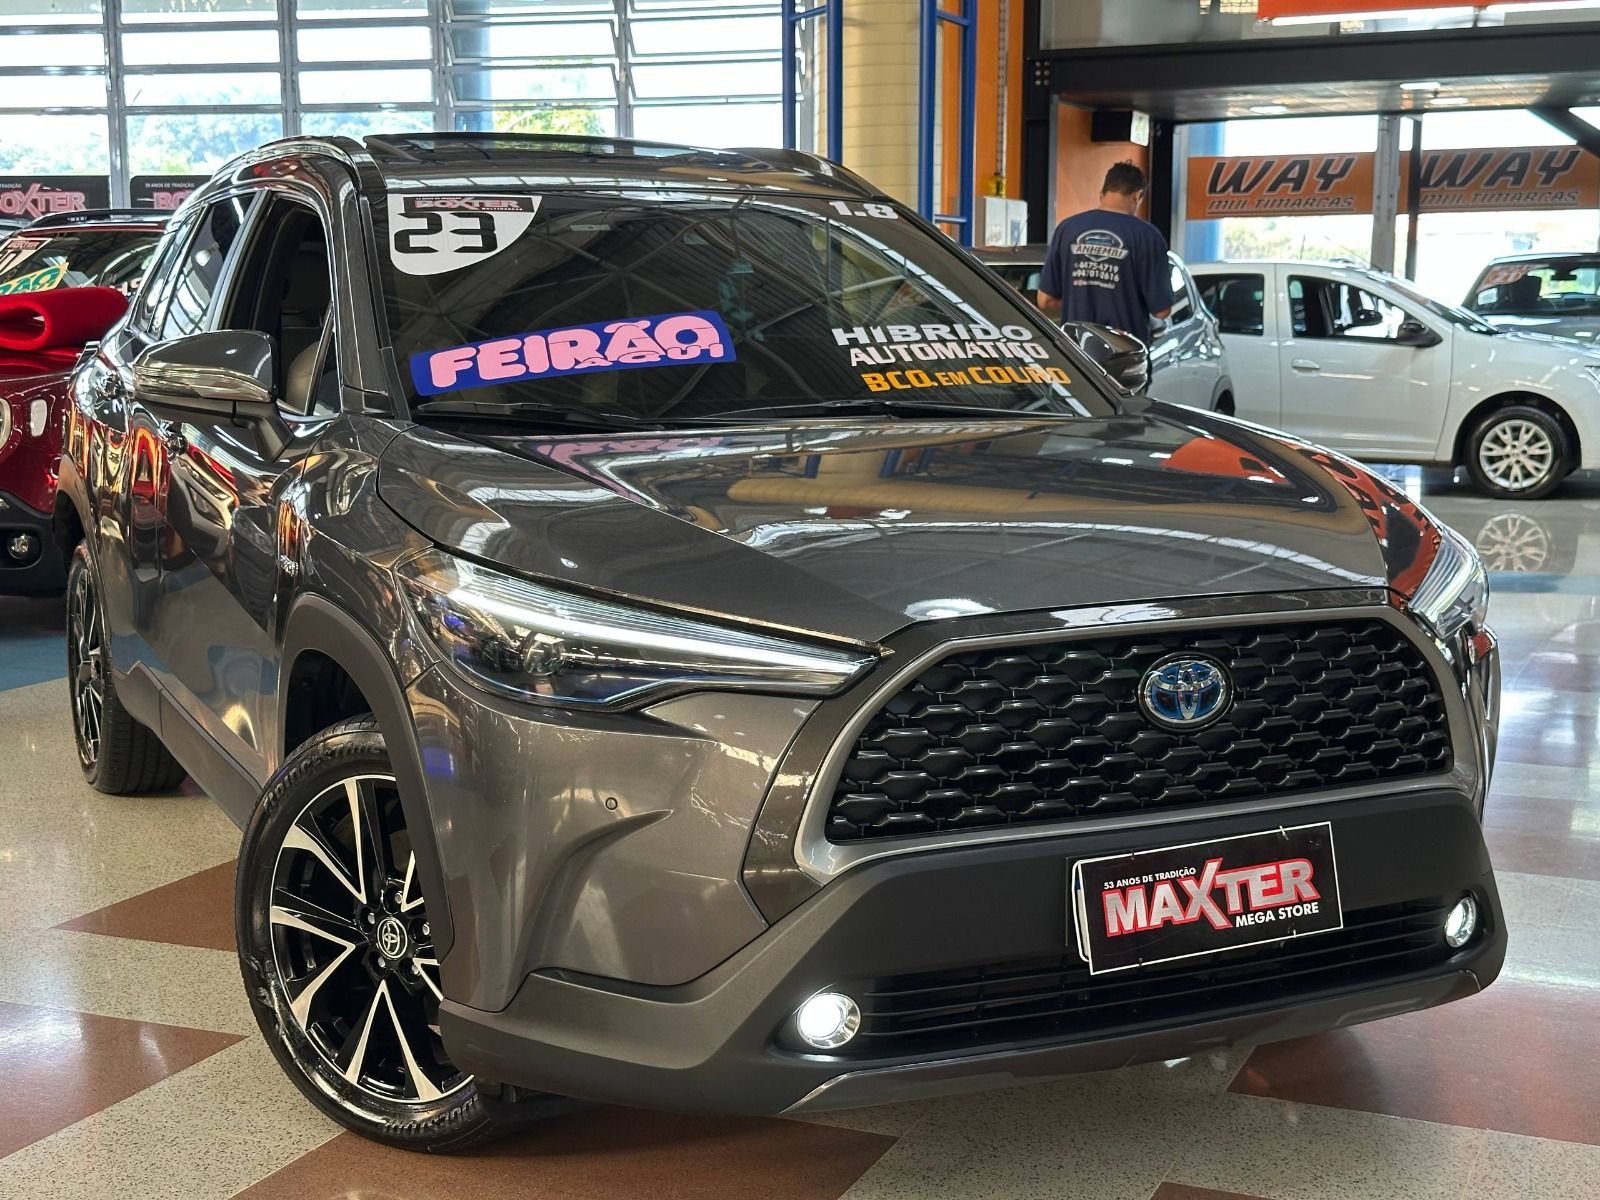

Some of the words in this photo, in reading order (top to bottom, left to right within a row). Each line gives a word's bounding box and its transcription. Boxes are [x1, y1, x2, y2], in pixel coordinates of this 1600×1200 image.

[1207, 157, 1357, 195] WAY
[1419, 149, 1582, 191] WAY
[414, 197, 521, 211] BOXTER
[829, 201, 899, 220] 1.8
[1208, 197, 1356, 212] MULTIMARCAS
[393, 211, 498, 254] 23
[1075, 245, 1123, 257] ANHEMBI
[429, 315, 720, 388] FEIRÃO
[934, 370, 972, 386] EM
[967, 366, 1072, 385] COURO
[1103, 881, 1115, 890] 53
[1116, 876, 1141, 888] ANOS
[1142, 873, 1154, 883] DE
[1154, 867, 1197, 881] TRADIÇÃO
[1102, 857, 1320, 937] MAXTER
[1235, 913, 1276, 928] MEGA
[1278, 902, 1320, 920] STORE
